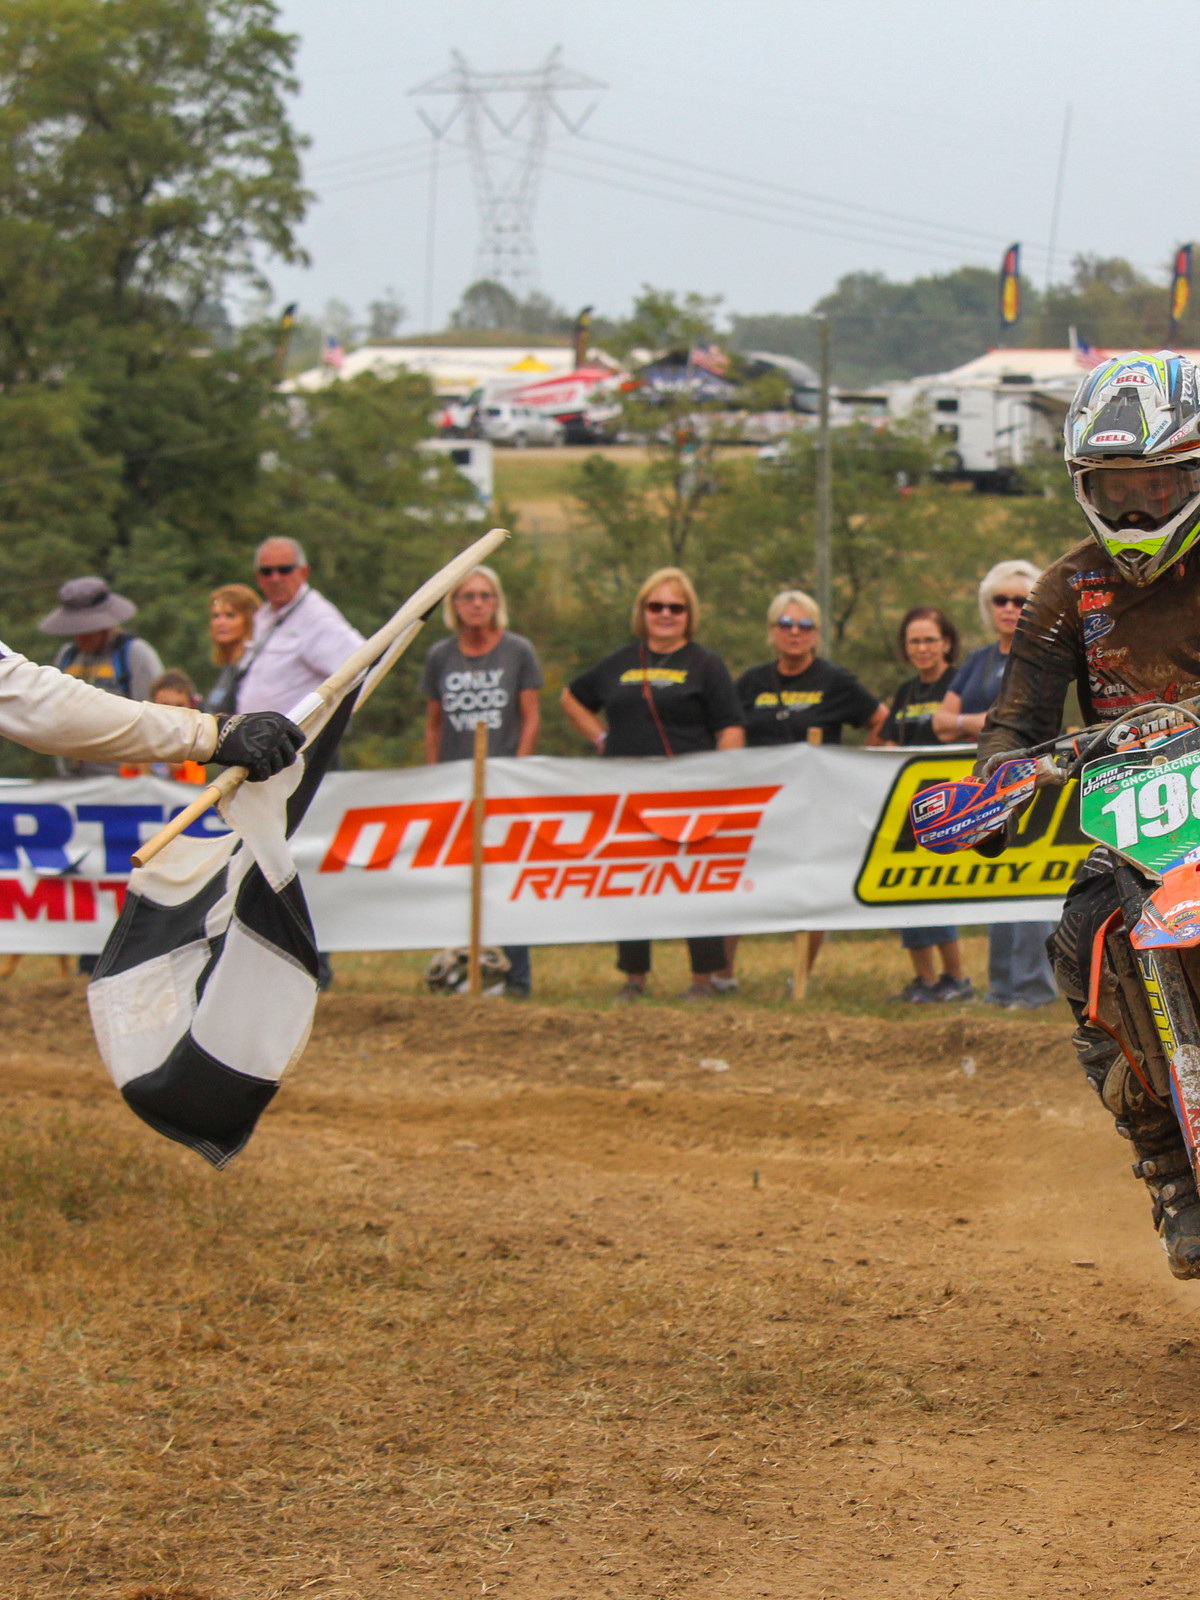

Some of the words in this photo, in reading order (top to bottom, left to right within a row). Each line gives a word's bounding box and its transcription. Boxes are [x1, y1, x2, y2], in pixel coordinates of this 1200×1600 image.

[1115, 374, 1148, 385] BELL
[1095, 434, 1128, 443] BELL
[445, 669, 504, 691] ONLY
[442, 688, 509, 712] GOOD
[1083, 769, 1134, 797] DRAPER
[319, 784, 785, 873] MOOSE
[510, 858, 747, 901] RACING
[878, 862, 1031, 889] UTILITY
